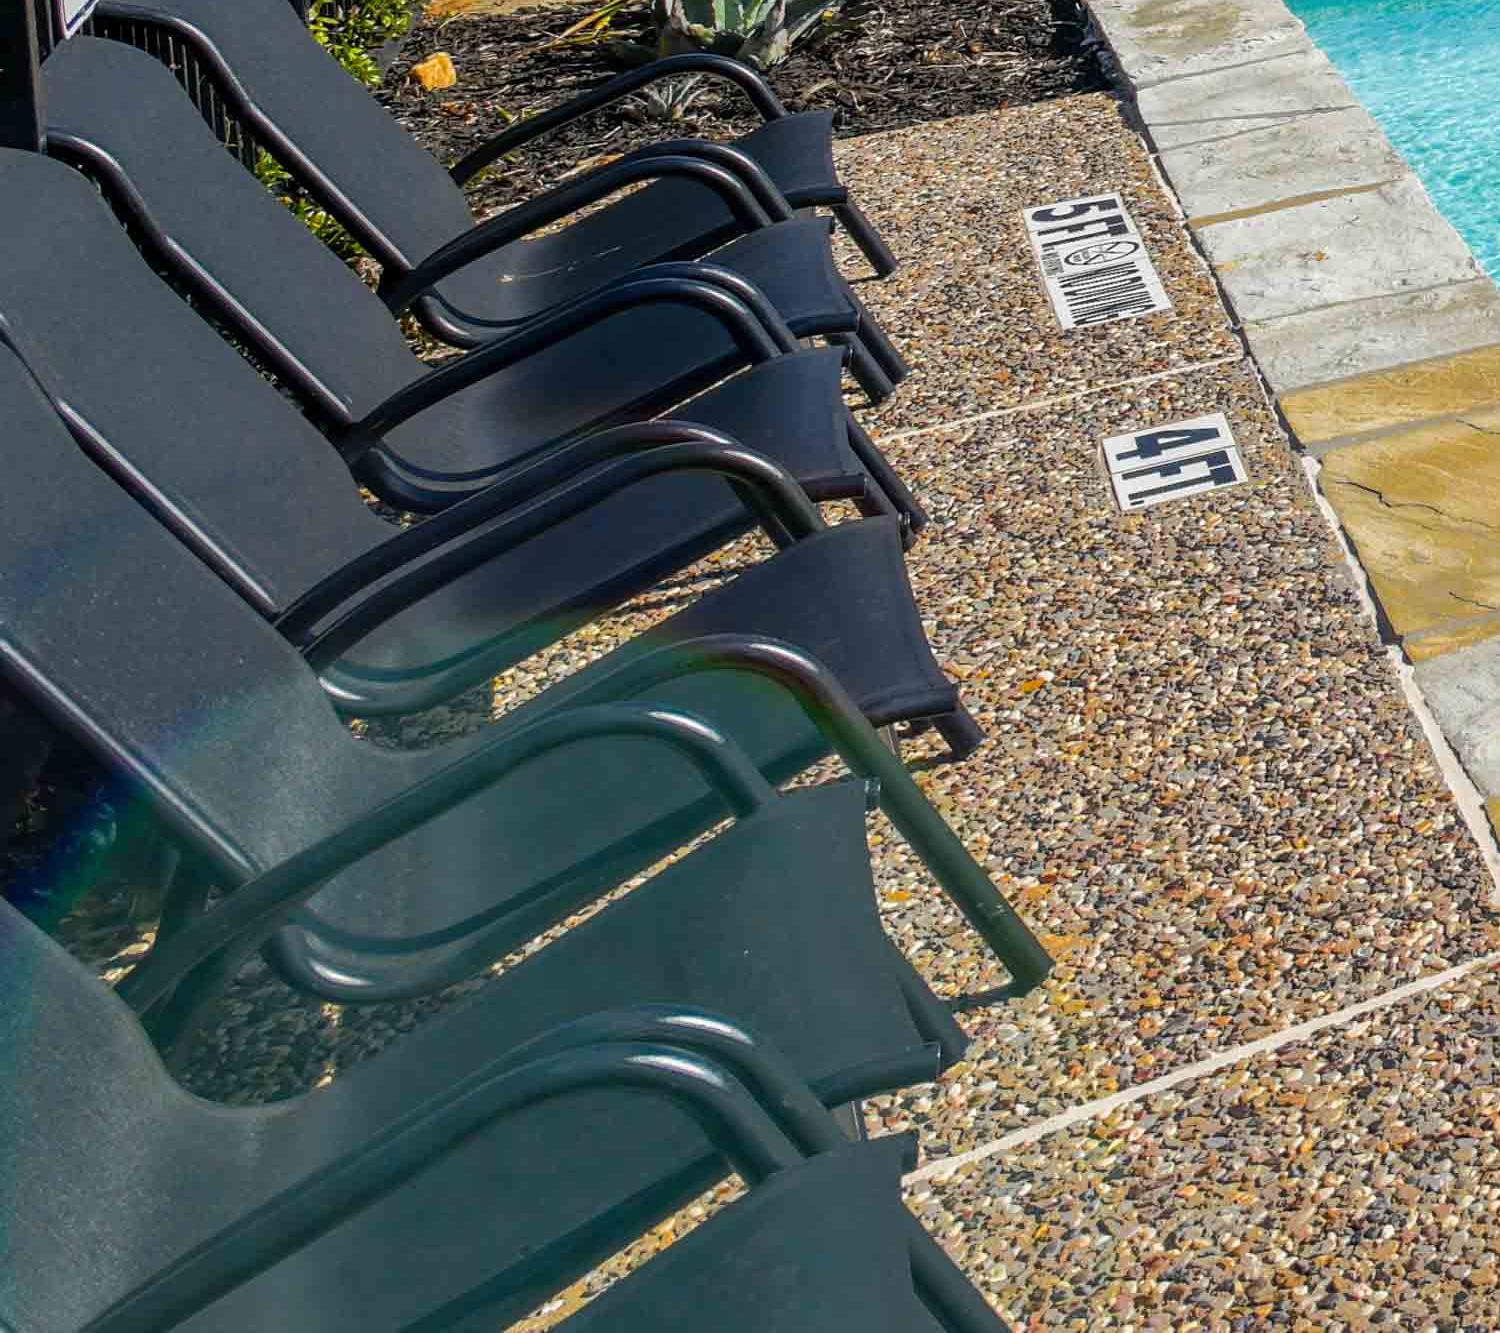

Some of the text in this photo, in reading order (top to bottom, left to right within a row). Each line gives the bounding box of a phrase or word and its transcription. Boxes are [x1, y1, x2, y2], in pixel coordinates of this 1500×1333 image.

[1032, 198, 1119, 221] 5
[1057, 262, 1156, 325] NO DIVING
[1116, 428, 1220, 460] 4
